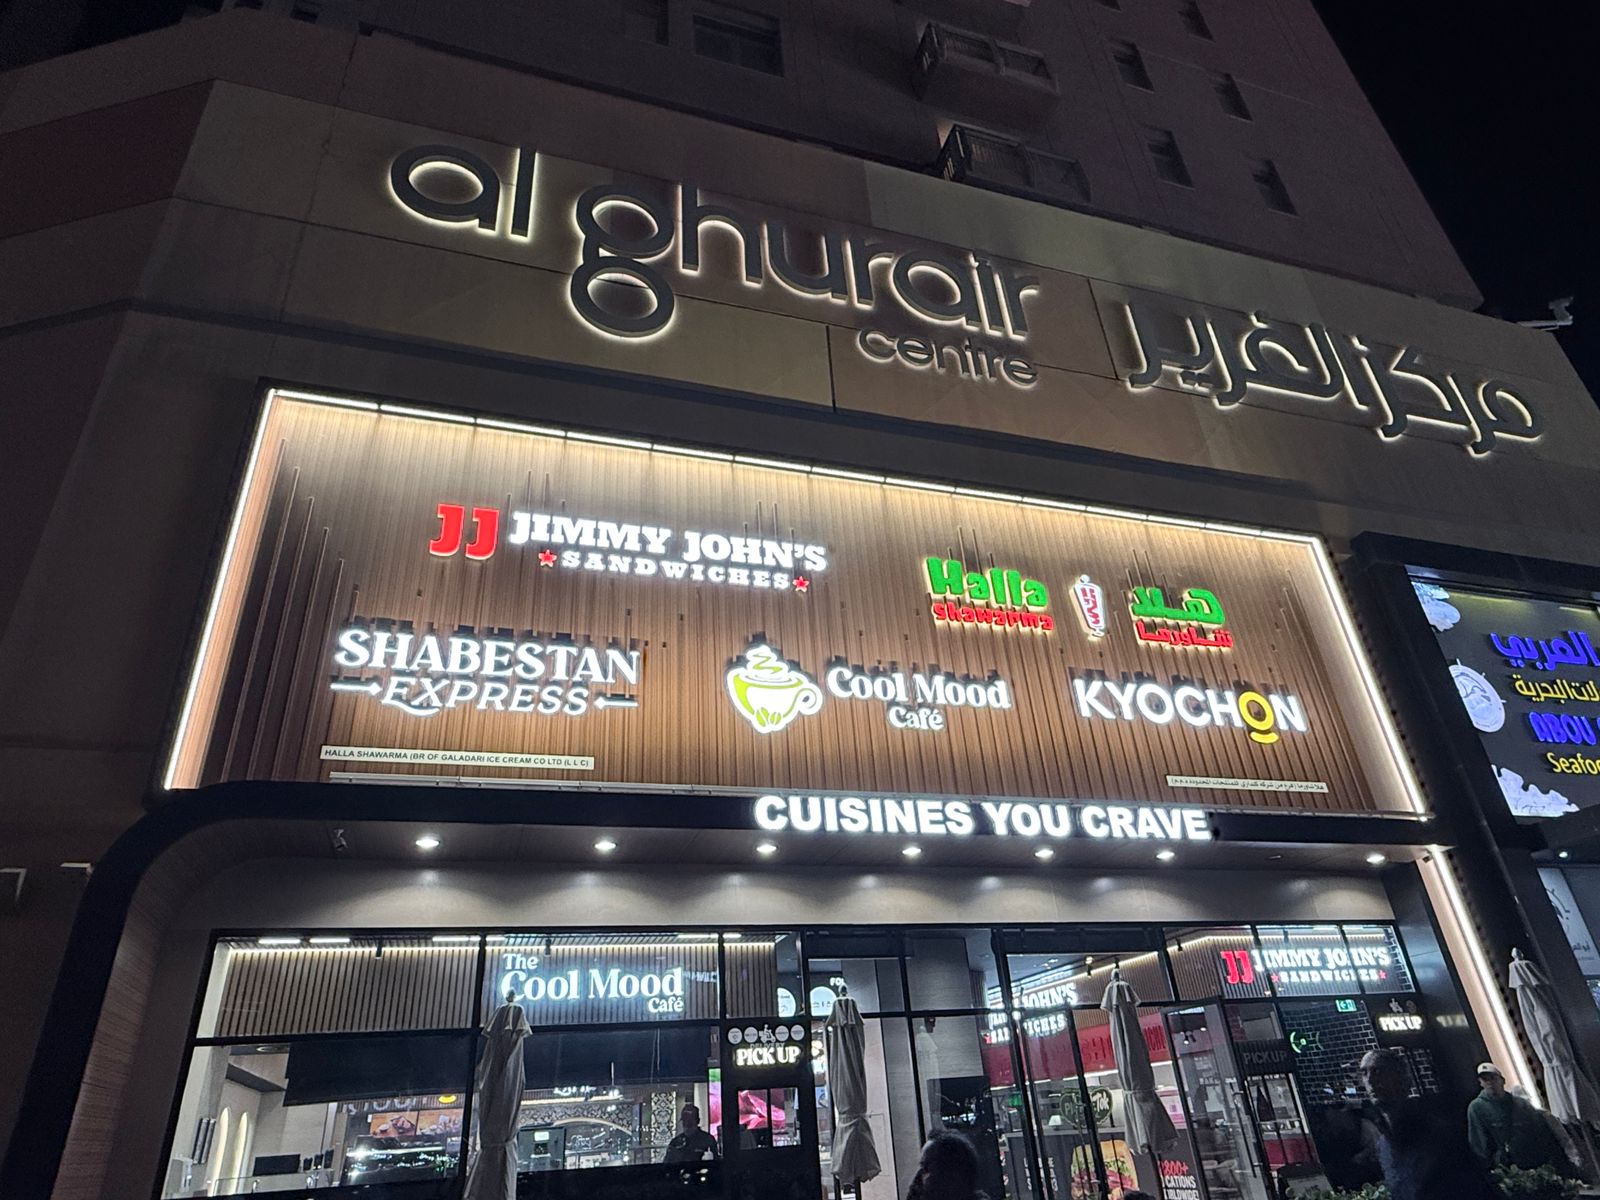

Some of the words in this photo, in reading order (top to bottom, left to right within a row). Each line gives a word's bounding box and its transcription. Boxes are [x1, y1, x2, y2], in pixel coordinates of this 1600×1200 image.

[388, 143, 540, 243] al
[567, 180, 1040, 341] ghurair
[856, 328, 1038, 388] centre
[1125, 303, 1370, 411] الغرير
[1352, 334, 1544, 458] مركز
[429, 502, 499, 560] JJ
[508, 510, 671, 555] JIMMY
[683, 529, 827, 573] JOHN'S
[561, 550, 791, 591] SANDWICHES
[925, 556, 1049, 609] Halla
[1130, 586, 1226, 625] هلا
[1135, 619, 1234, 649] شاورما
[1489, 629, 1600, 672] العربي
[334, 627, 641, 687] SHABESTAN
[380, 674, 590, 718] EXPRESS
[826, 666, 910, 702] Cool
[913, 671, 1012, 710] Mood
[1073, 678, 1309, 733] KYOCHON
[1512, 674, 1574, 704] البحرية
[888, 705, 945, 731] Café
[324, 748, 355, 758] HALLA
[356, 749, 408, 760] SHAWARMA
[409, 752, 425, 761] (BR
[427, 752, 439, 761] OF
[440, 753, 485, 763] GALADARI
[486, 755, 500, 763] ICE
[502, 756, 532, 764] CREAM
[533, 757, 546, 765] CO
[547, 758, 562, 766] LTD
[754, 794, 975, 836] CUISINES
[979, 801, 1073, 838] YOU
[1081, 804, 1213, 841] CRAVE
[503, 953, 539, 970] The
[1220, 949, 1255, 985] JJ
[1251, 948, 1323, 973] JIMMY
[501, 968, 581, 1002] Cool
[588, 966, 685, 1000] Mood
[648, 996, 686, 1014] Café
[736, 1047, 776, 1067] PICK
[777, 1044, 801, 1064] UP
